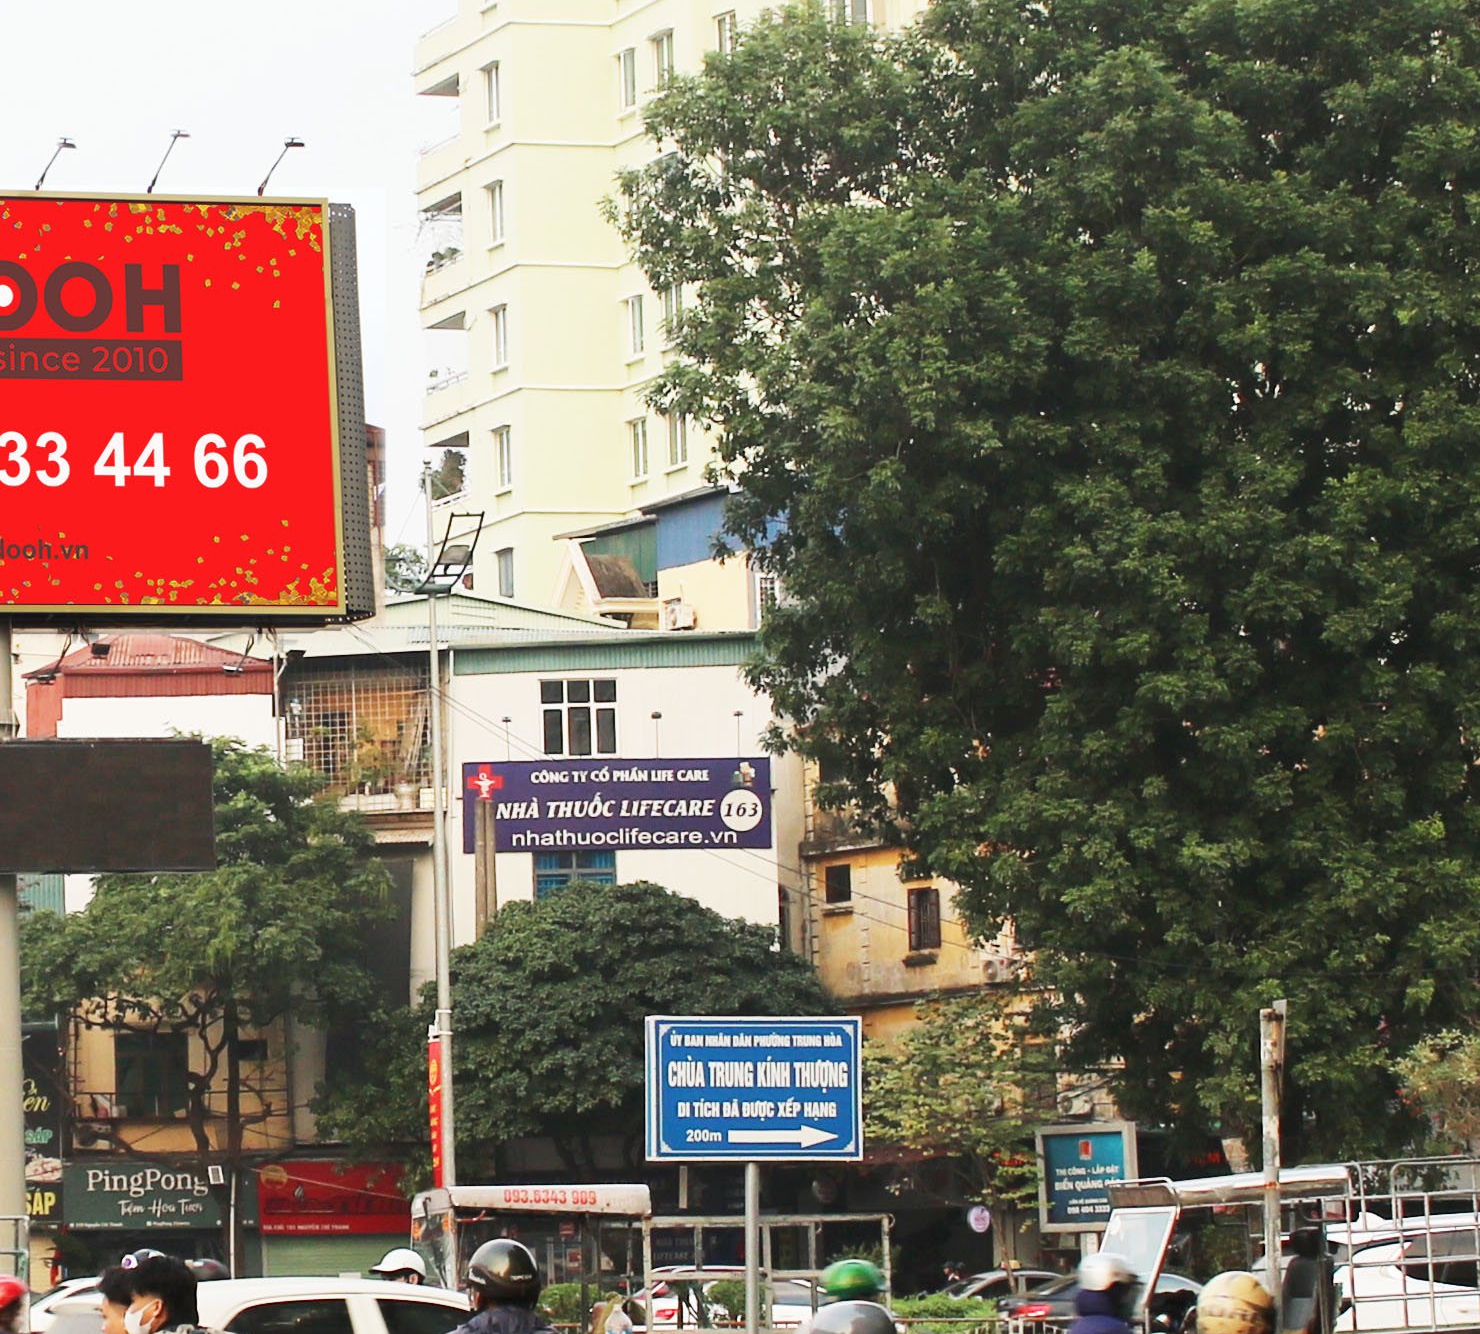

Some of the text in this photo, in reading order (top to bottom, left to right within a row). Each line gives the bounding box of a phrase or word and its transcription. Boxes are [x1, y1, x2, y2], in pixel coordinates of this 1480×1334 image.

[92, 346, 168, 373] 2010
[93, 432, 171, 487] 44
[193, 433, 268, 489] 66
[530, 768, 569, 784] CÔNG
[572, 770, 588, 783] TY
[650, 769, 674, 782] LIFE
[676, 769, 709, 782] CARE
[496, 792, 759, 820] NHÀ THUỐC LIFECARE 163
[512, 828, 738, 848] nhathuoclifecare.vn
[670, 1030, 843, 1047] ỦY BAN NHÂN DÂN PHƯỜNG TRUNG HÒA
[667, 1055, 849, 1094] CHÙA TRUNG KÍNH THƯỢNG
[677, 1096, 837, 1122] DI TÍCH ĐÃ ĐƯỢC XẾP HẠNG
[686, 1129, 722, 1142] 200m
[572, 1189, 597, 1205] 909
[147, 1198, 176, 1218] Hoa
